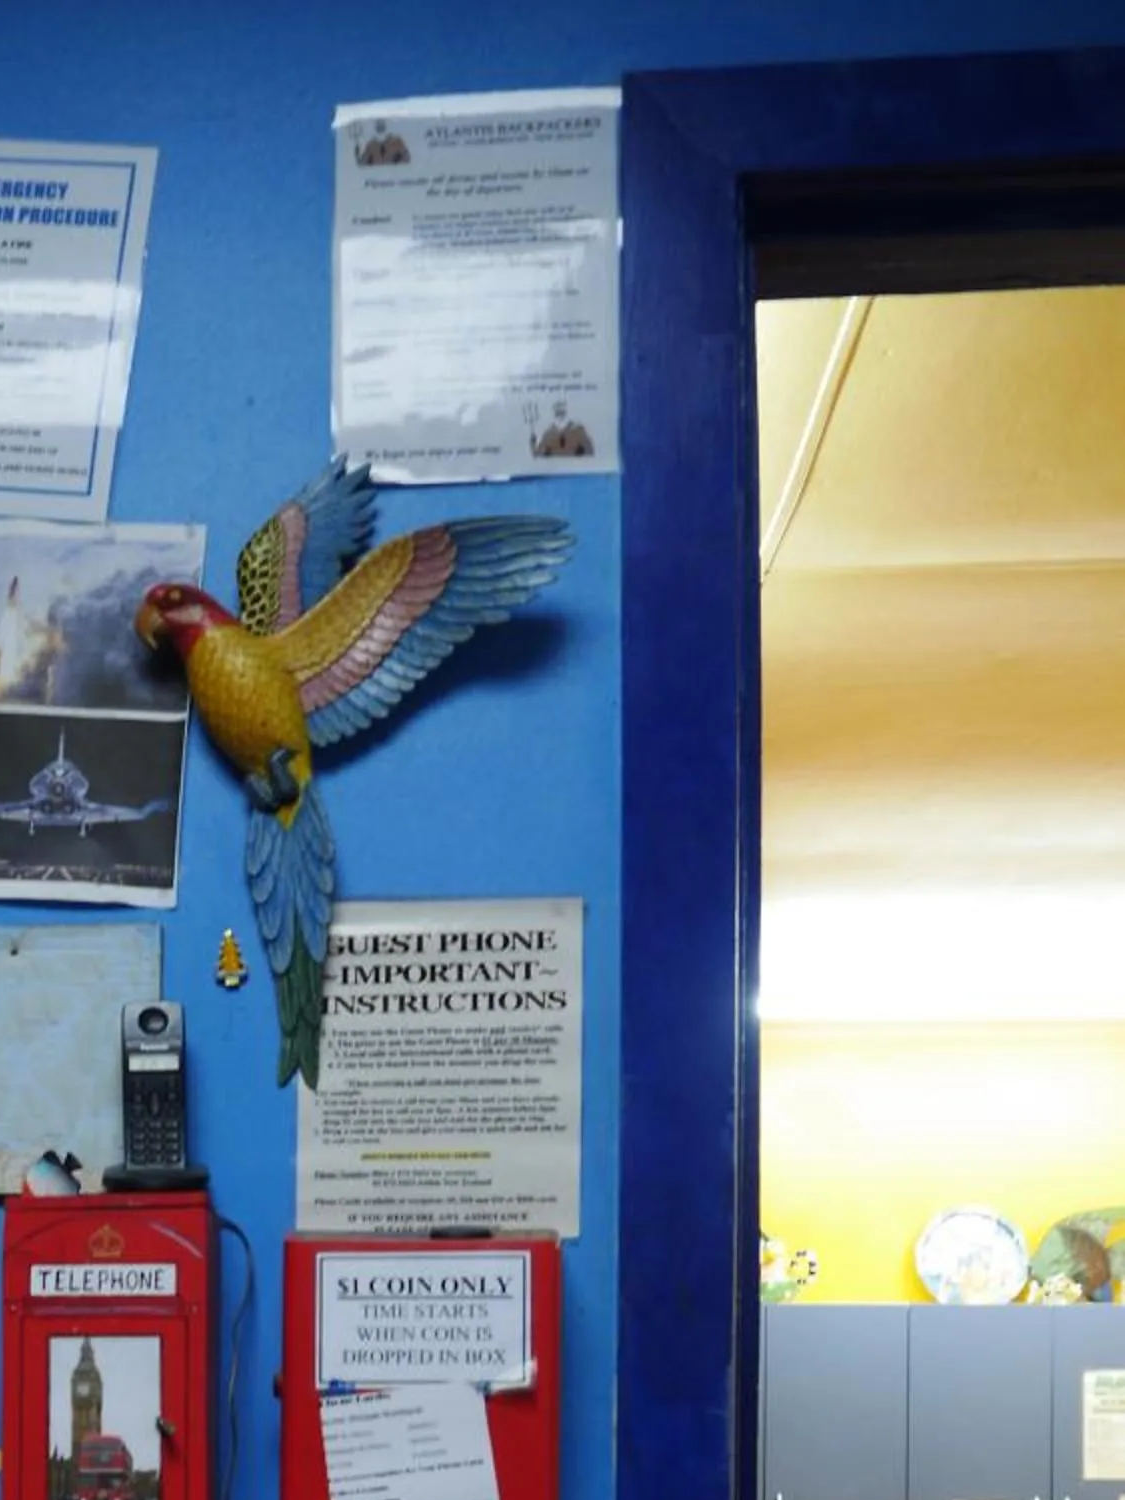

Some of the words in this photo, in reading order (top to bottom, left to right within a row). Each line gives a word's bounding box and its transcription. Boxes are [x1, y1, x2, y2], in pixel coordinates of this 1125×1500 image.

[16, 206, 120, 228] PROCEDURE
[328, 931, 432, 957] GUEST
[440, 929, 558, 953] PHONE
[321, 989, 568, 1017] INSTRUCTIONS
[37, 1268, 166, 1293] TELEPHONE
[369, 1276, 432, 1295] COIN
[439, 1275, 513, 1295] ONLY
[362, 1304, 409, 1320] TIME
[413, 1303, 489, 1320] STARTS
[357, 1327, 417, 1343] WHEN
[420, 1326, 472, 1342] COIN
[475, 1326, 493, 1341] IS
[342, 1349, 434, 1366] DROPPED
[439, 1349, 459, 1365] IN
[463, 1349, 506, 1365] BOX
